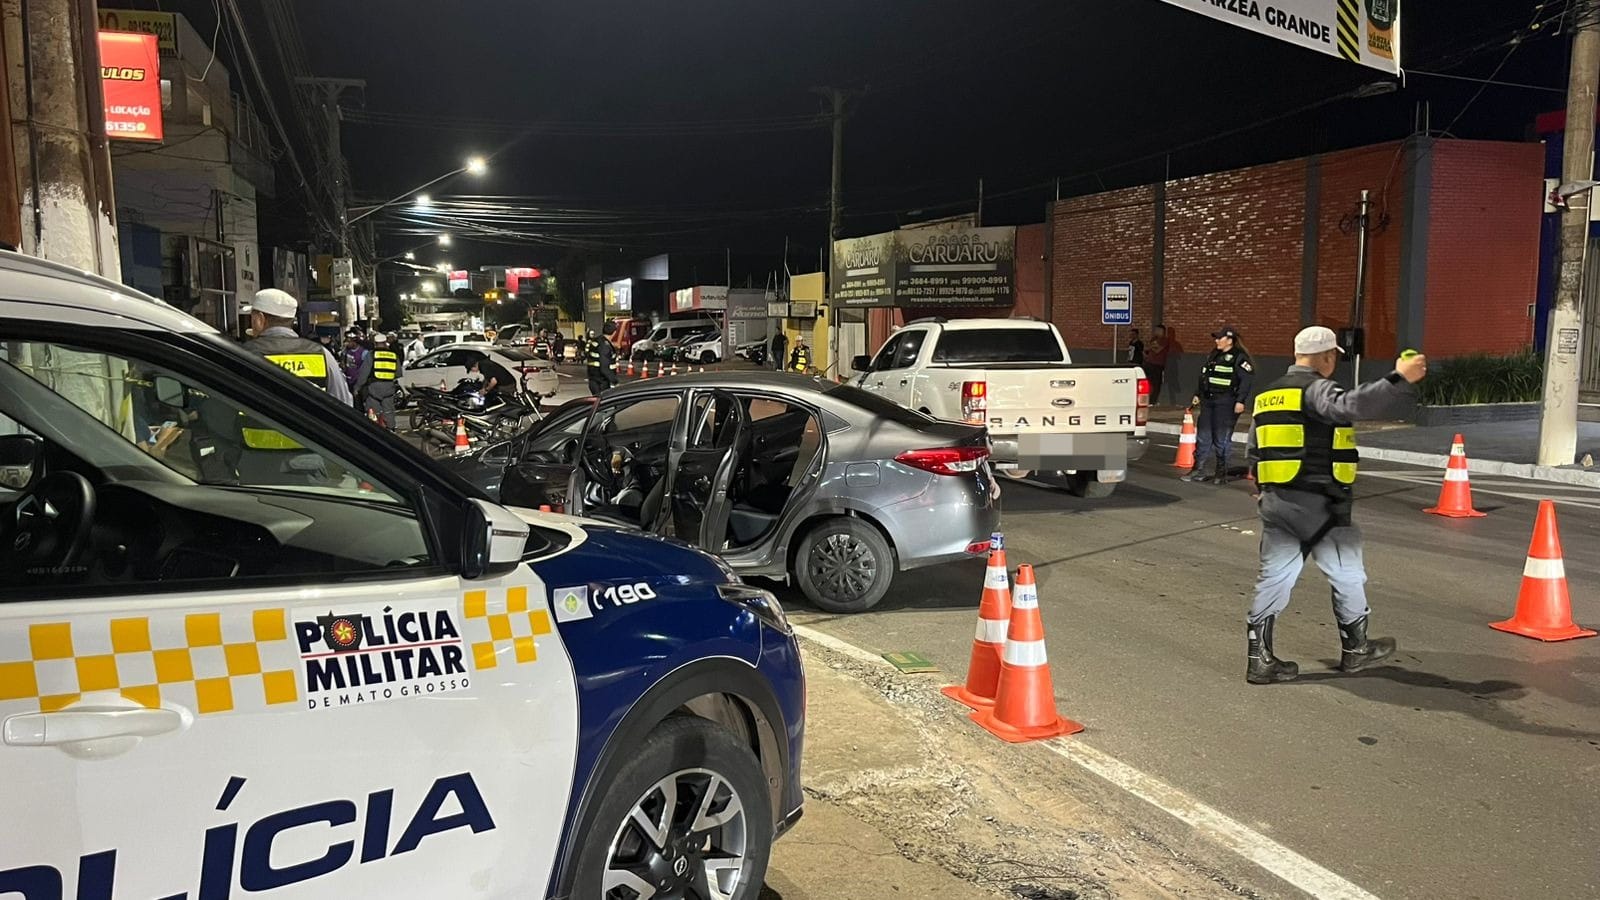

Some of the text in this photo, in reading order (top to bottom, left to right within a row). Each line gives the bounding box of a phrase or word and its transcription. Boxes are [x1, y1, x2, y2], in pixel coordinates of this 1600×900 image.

[1202, 0, 1331, 44] RZEA GRANDE
[101, 67, 145, 81] ULOS
[105, 121, 137, 131] 6135
[909, 242, 998, 263] CARUARU
[989, 414, 1132, 429] RANGER
[604, 582, 657, 606] 190
[306, 644, 467, 693] MILITAR
[308, 678, 470, 710] DE MATO GROSSO
[0, 772, 496, 900] LÍCIA
